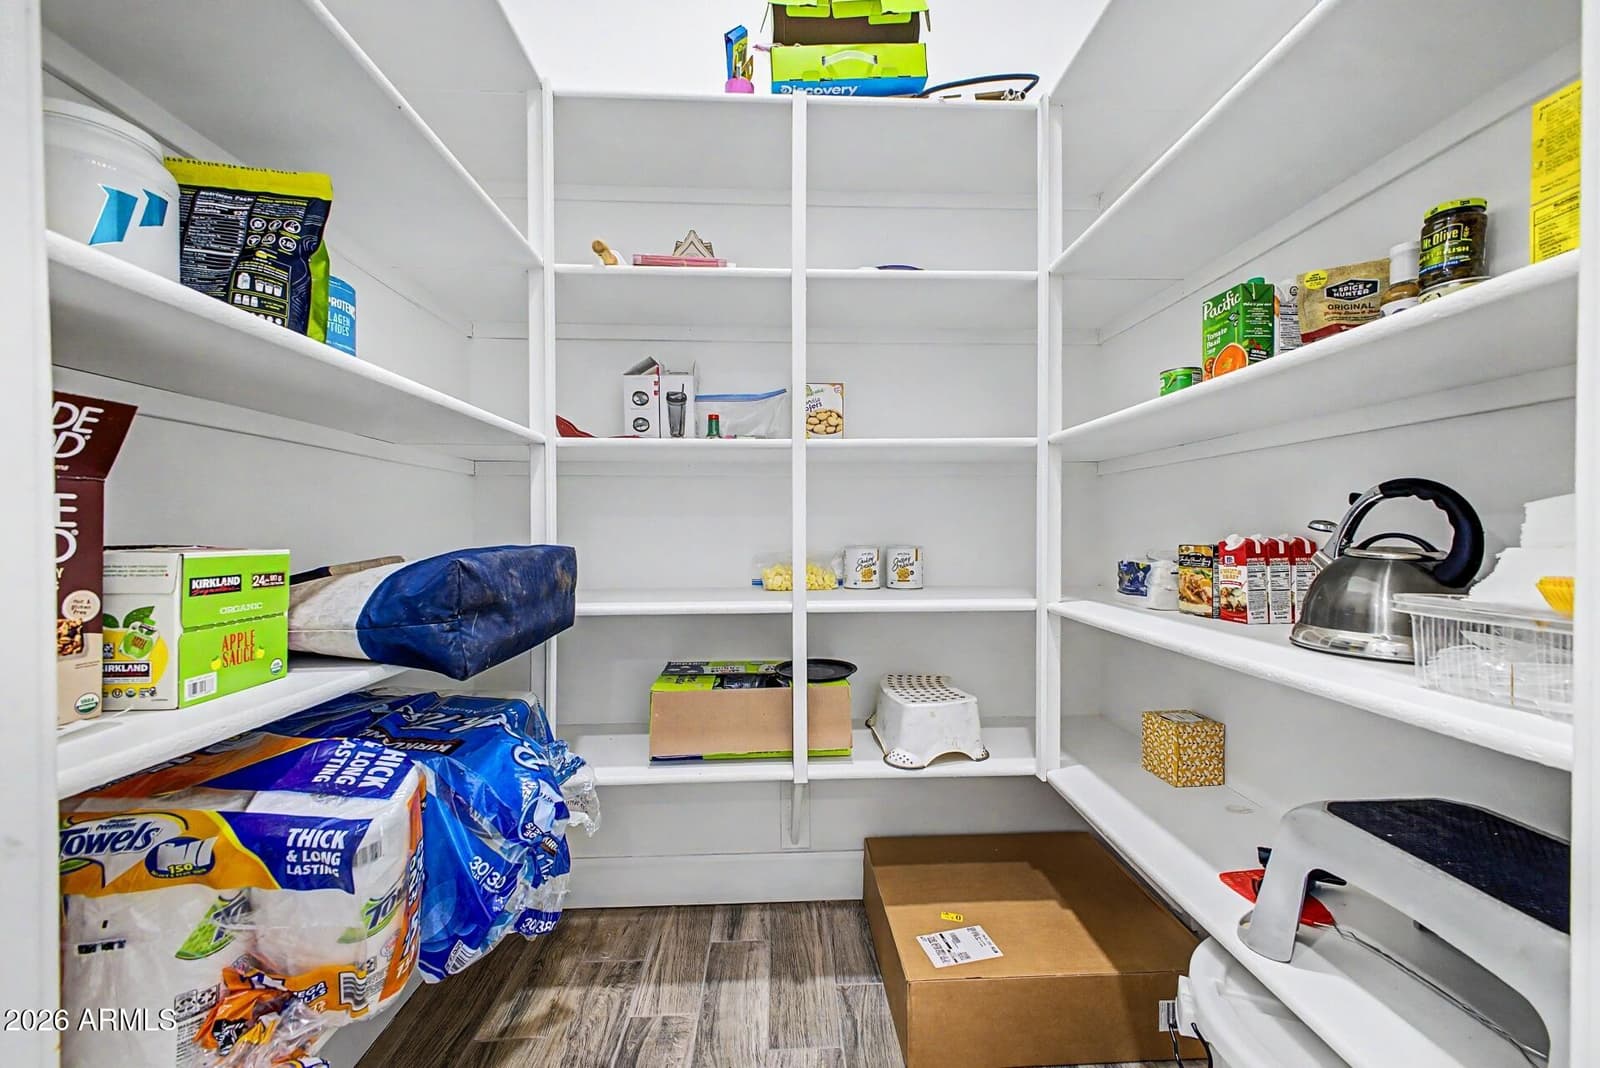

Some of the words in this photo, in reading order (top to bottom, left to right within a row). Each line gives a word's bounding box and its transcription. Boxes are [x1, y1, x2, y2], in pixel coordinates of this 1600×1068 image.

[1432, 228, 1459, 246] Olive
[1333, 288, 1370, 298] HUNTER
[1338, 283, 1365, 293] SPICE
[1202, 290, 1242, 321] Pacific
[1327, 302, 1376, 311] ORIGINAL
[192, 576, 241, 590] KIRKLAND
[219, 602, 263, 615] ORGANIC
[222, 629, 255, 652] APPLE
[222, 645, 255, 669] SAUCE
[103, 663, 148, 674] IRKLAND
[311, 737, 357, 783] ASTING
[334, 751, 376, 786] LONG
[357, 747, 408, 789] HICK
[60, 821, 161, 856] Towels
[286, 828, 349, 850] THICK
[286, 850, 298, 863] &
[302, 850, 342, 867] LONG
[167, 863, 194, 875] 150
